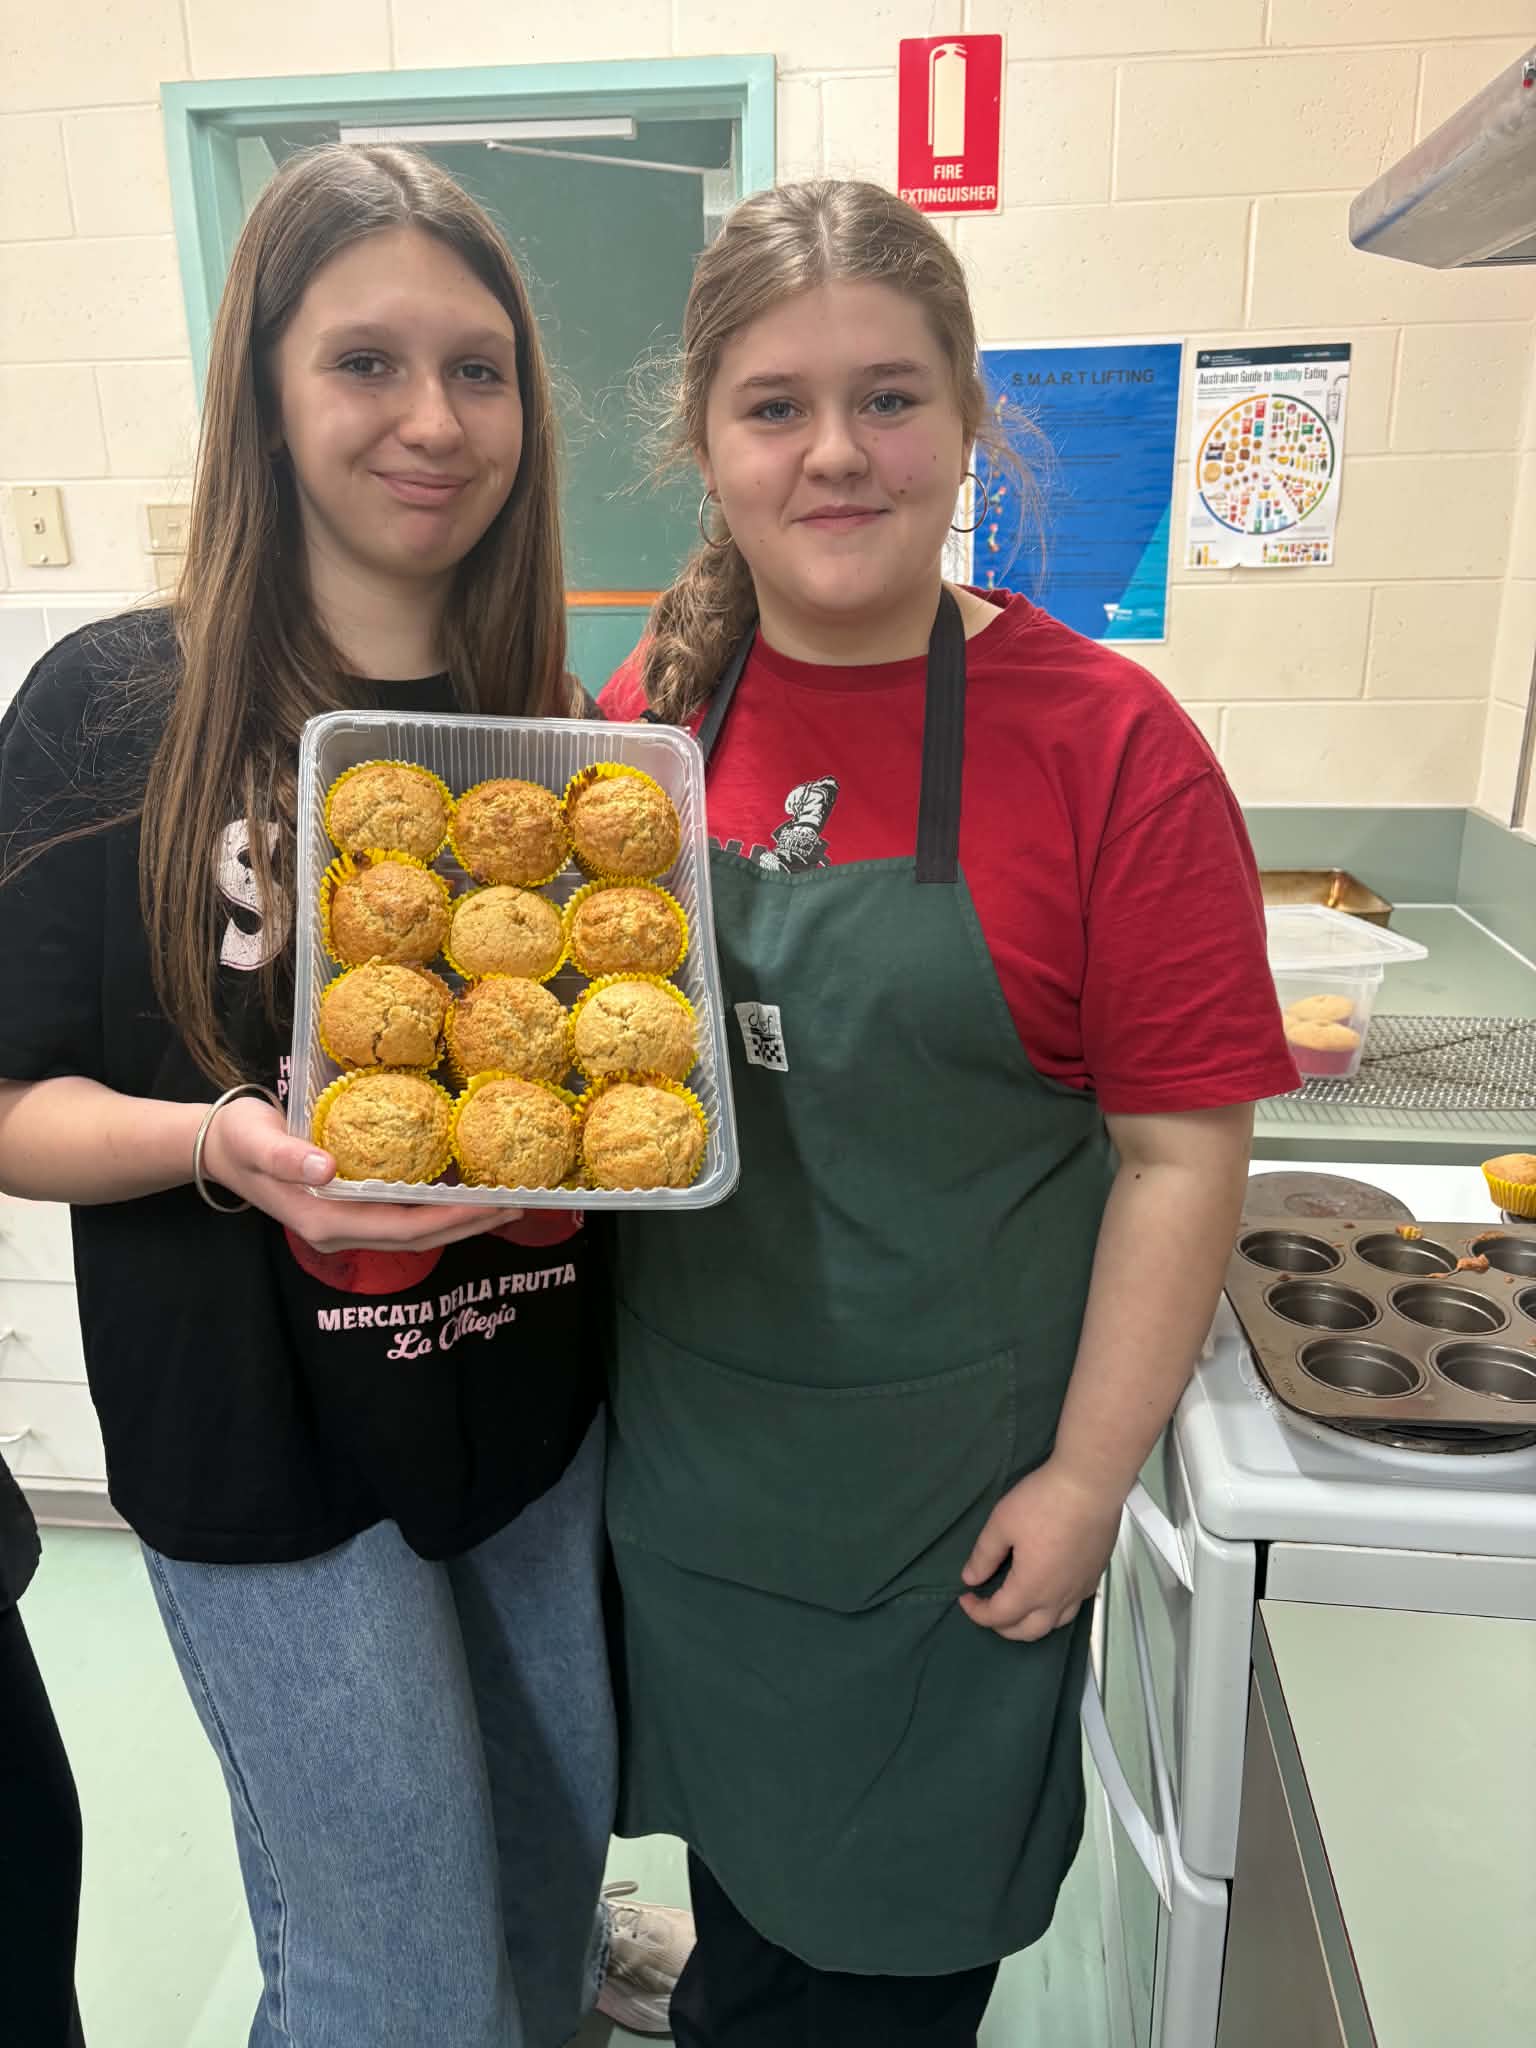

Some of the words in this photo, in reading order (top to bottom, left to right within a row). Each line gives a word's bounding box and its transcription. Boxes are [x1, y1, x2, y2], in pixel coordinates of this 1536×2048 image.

[933, 164, 964, 180] FIRE
[900, 185, 996, 204] EXTINGUISHER
[1091, 368, 1154, 384] LIFTING
[1198, 372, 1239, 385] Australian
[1240, 370, 1263, 383] Guide
[1263, 370, 1272, 382] to
[1273, 368, 1303, 382] Healthy
[1304, 367, 1328, 382] Eating
[317, 1301, 434, 1331] MERCATA
[439, 1278, 493, 1318] DELLA
[498, 1263, 576, 1297] FRUTTA
[386, 1329, 433, 1360] La
